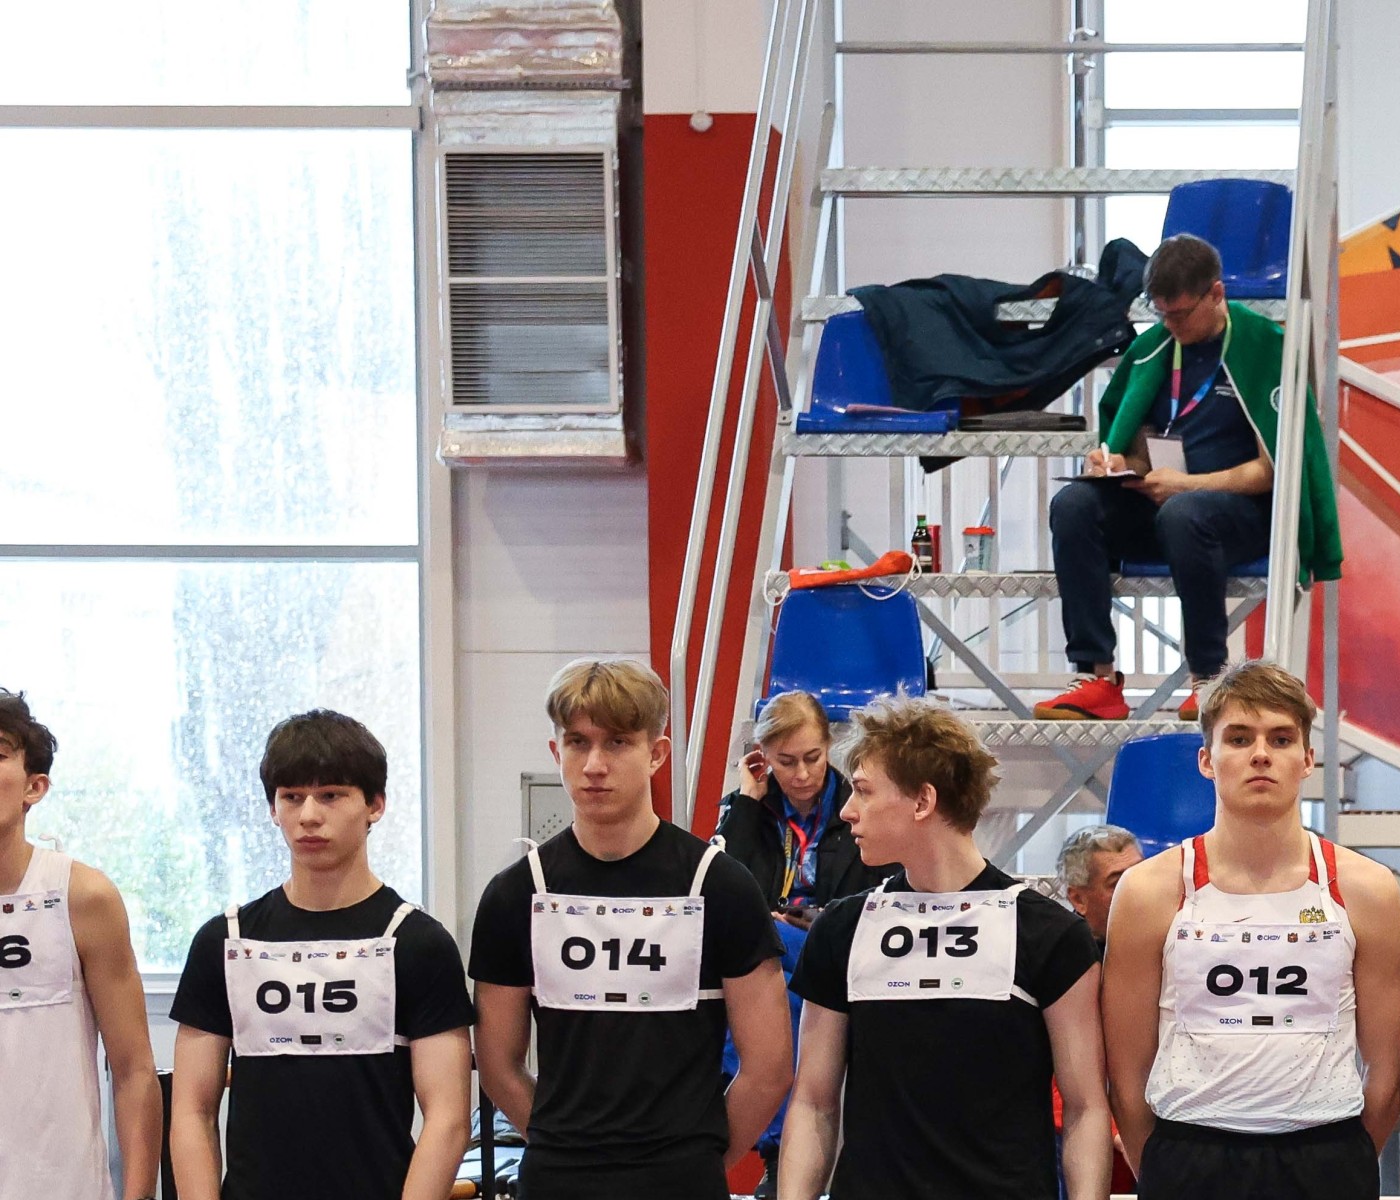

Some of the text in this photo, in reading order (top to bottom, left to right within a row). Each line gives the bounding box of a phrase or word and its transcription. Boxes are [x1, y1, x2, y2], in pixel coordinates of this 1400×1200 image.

[0, 935, 31, 968] 6
[561, 936, 666, 971] 014
[881, 926, 978, 958] 013
[1207, 964, 1308, 996] 012
[256, 980, 358, 1014] 015
